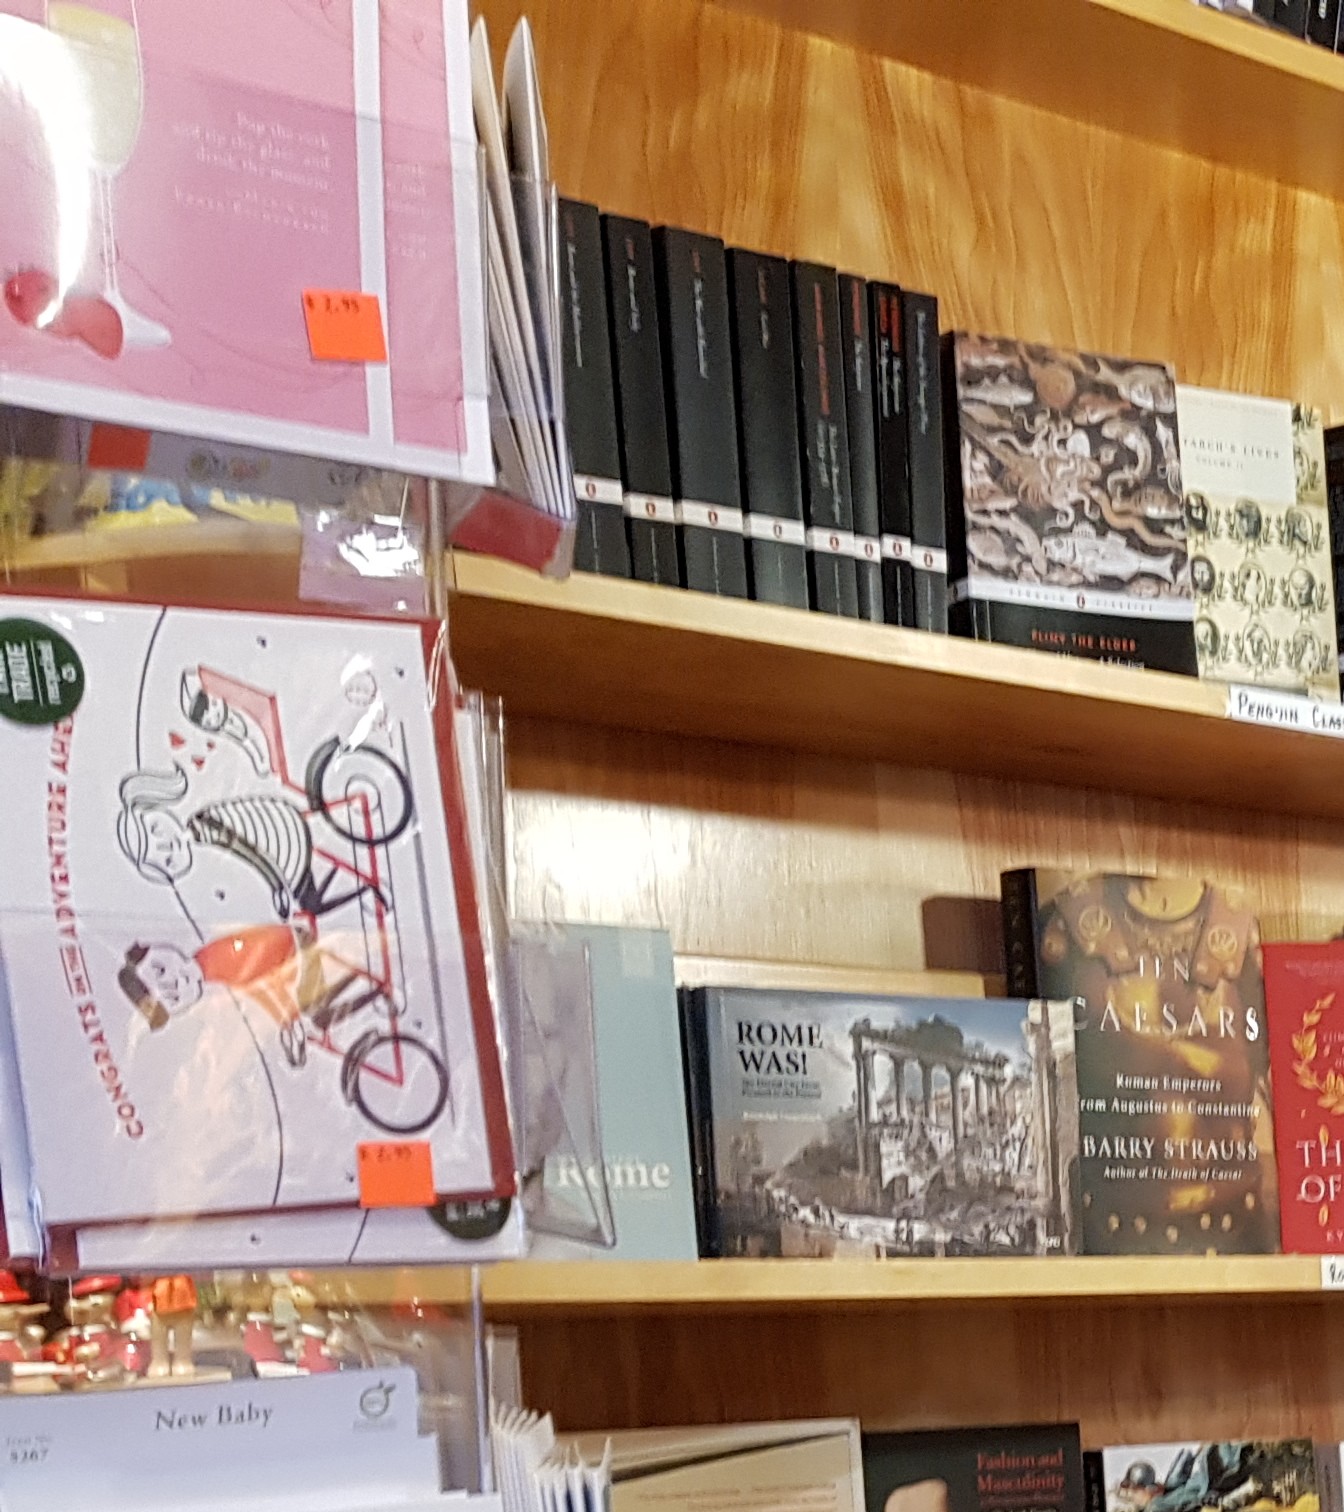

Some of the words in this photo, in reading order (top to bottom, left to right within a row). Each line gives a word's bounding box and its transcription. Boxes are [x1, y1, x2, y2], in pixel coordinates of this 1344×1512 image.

[47, 781, 79, 939] ADVENTURE
[736, 1021, 823, 1048] ROME
[1116, 1073, 1159, 1090] Roman
[1164, 1075, 1222, 1094] Emperors
[1111, 1097, 1168, 1116] Augustus
[1188, 1101, 1261, 1118] Constantine
[1083, 1135, 1155, 1159] BARRY
[1164, 1137, 1258, 1161] STRAUSS
[1297, 1173, 1342, 1203] OF
[154, 1409, 208, 1431] New
[217, 1402, 274, 1427] Baby
